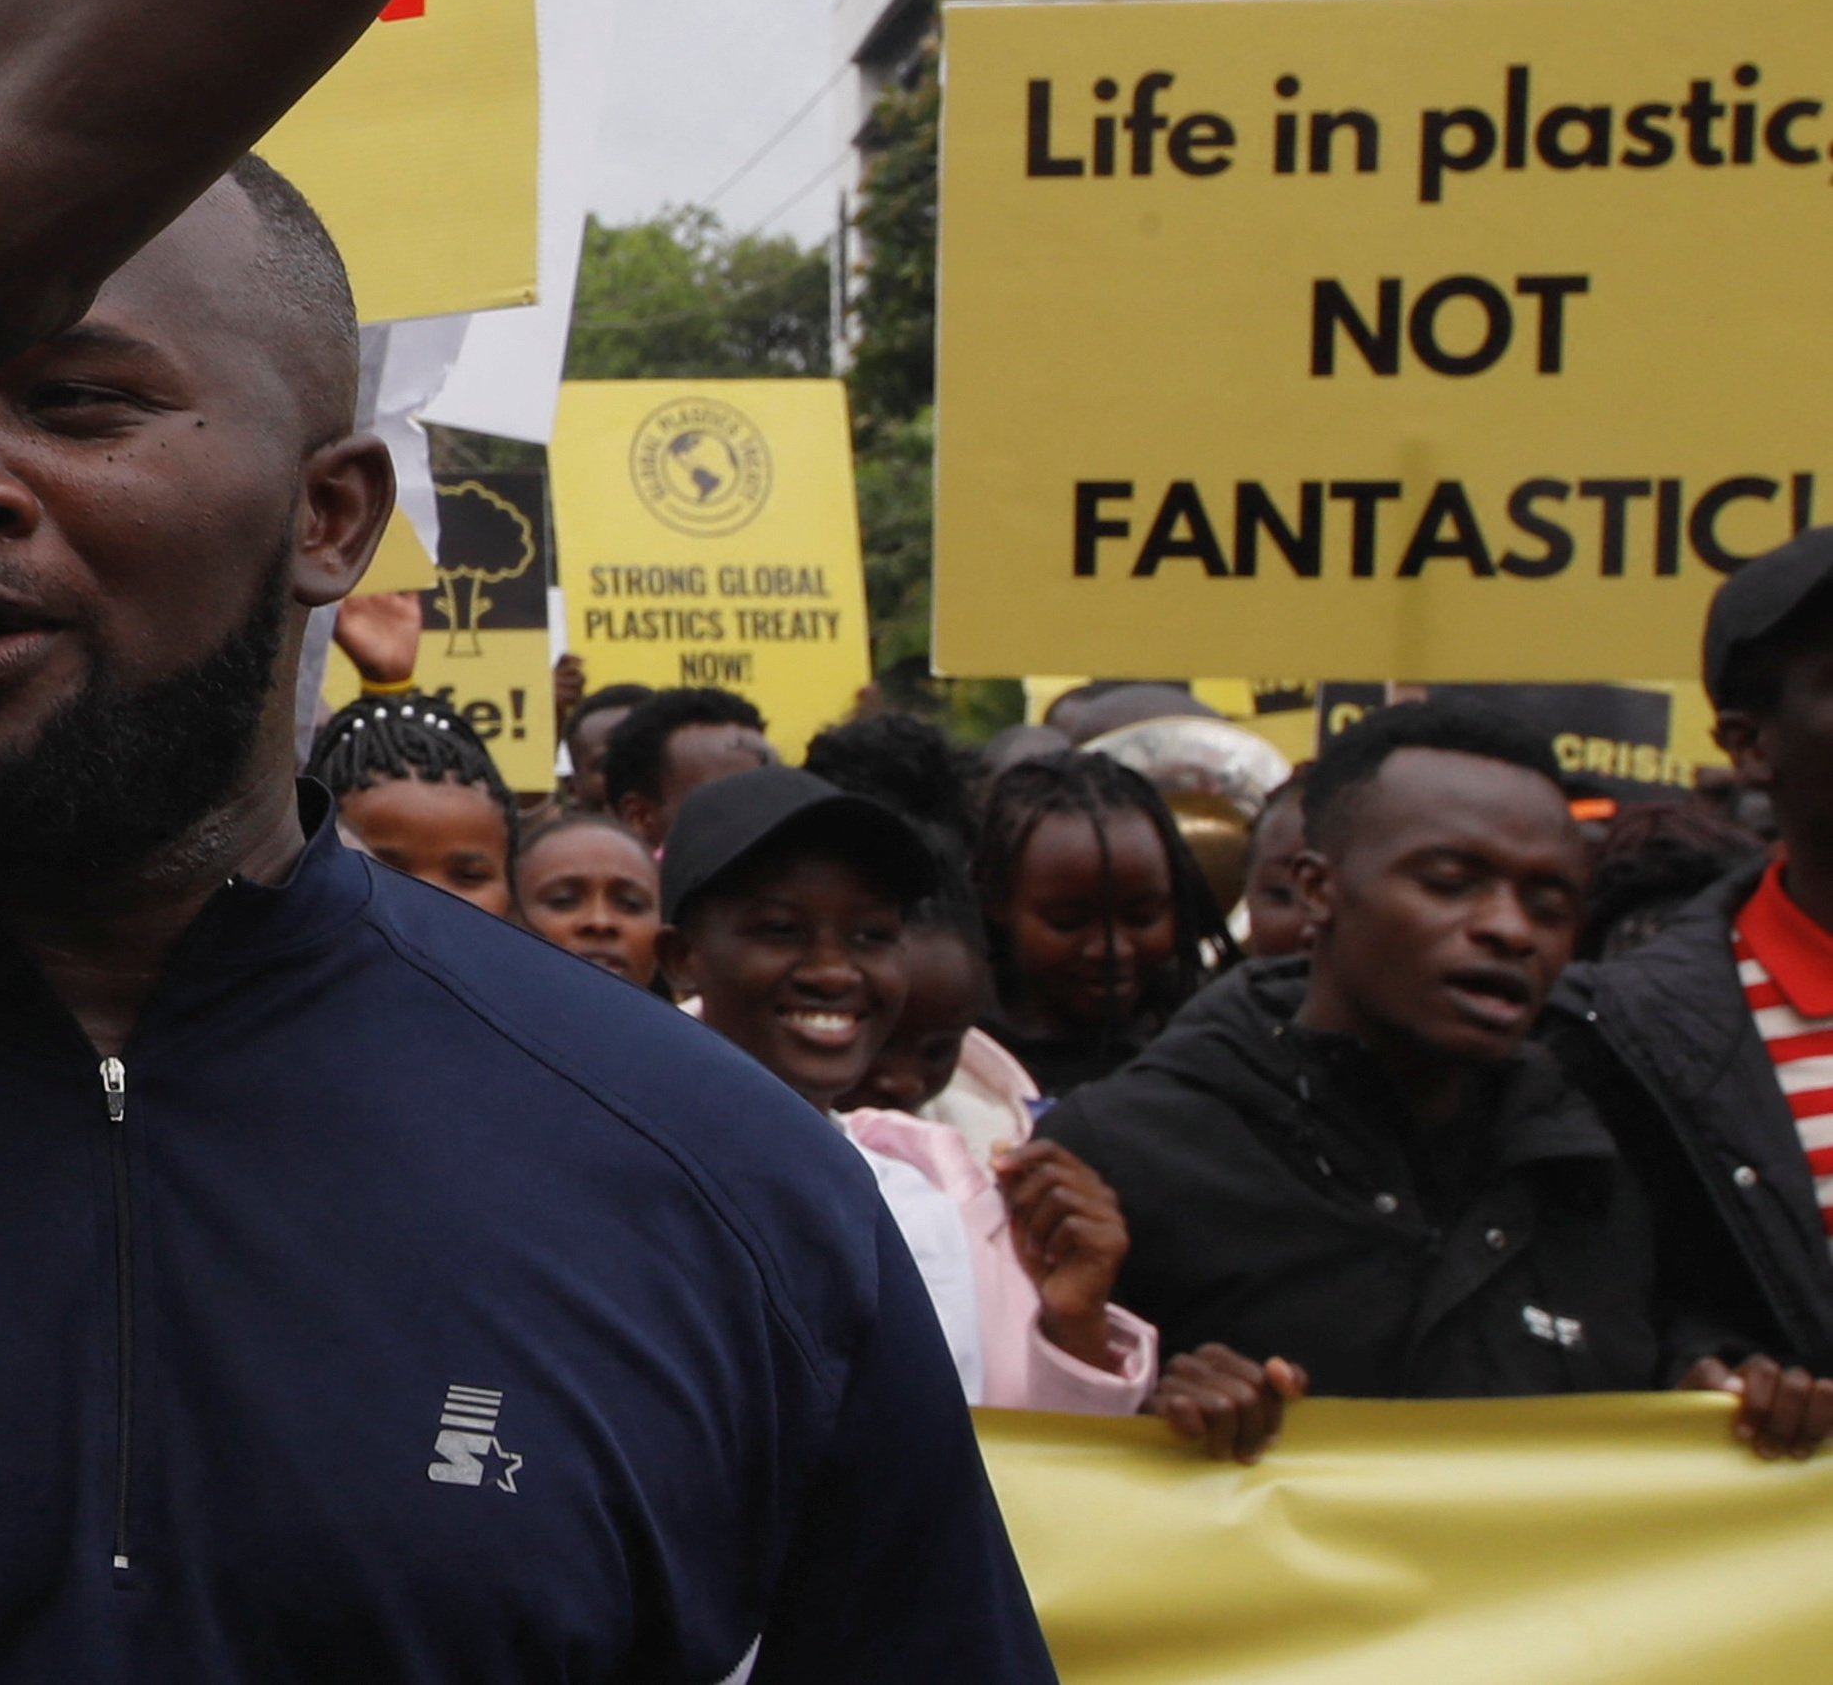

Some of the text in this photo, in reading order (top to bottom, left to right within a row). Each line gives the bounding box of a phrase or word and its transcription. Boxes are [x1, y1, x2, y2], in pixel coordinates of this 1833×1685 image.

[1026, 71, 1236, 177] Life
[1273, 73, 1380, 175] in
[1309, 274, 1590, 377] NOT
[1070, 471, 1814, 579] FANTASTIC!
[589, 565, 830, 598] STRONG GLOBAL
[585, 607, 841, 642] PLASTICS TREATY
[679, 649, 753, 684] NOW!
